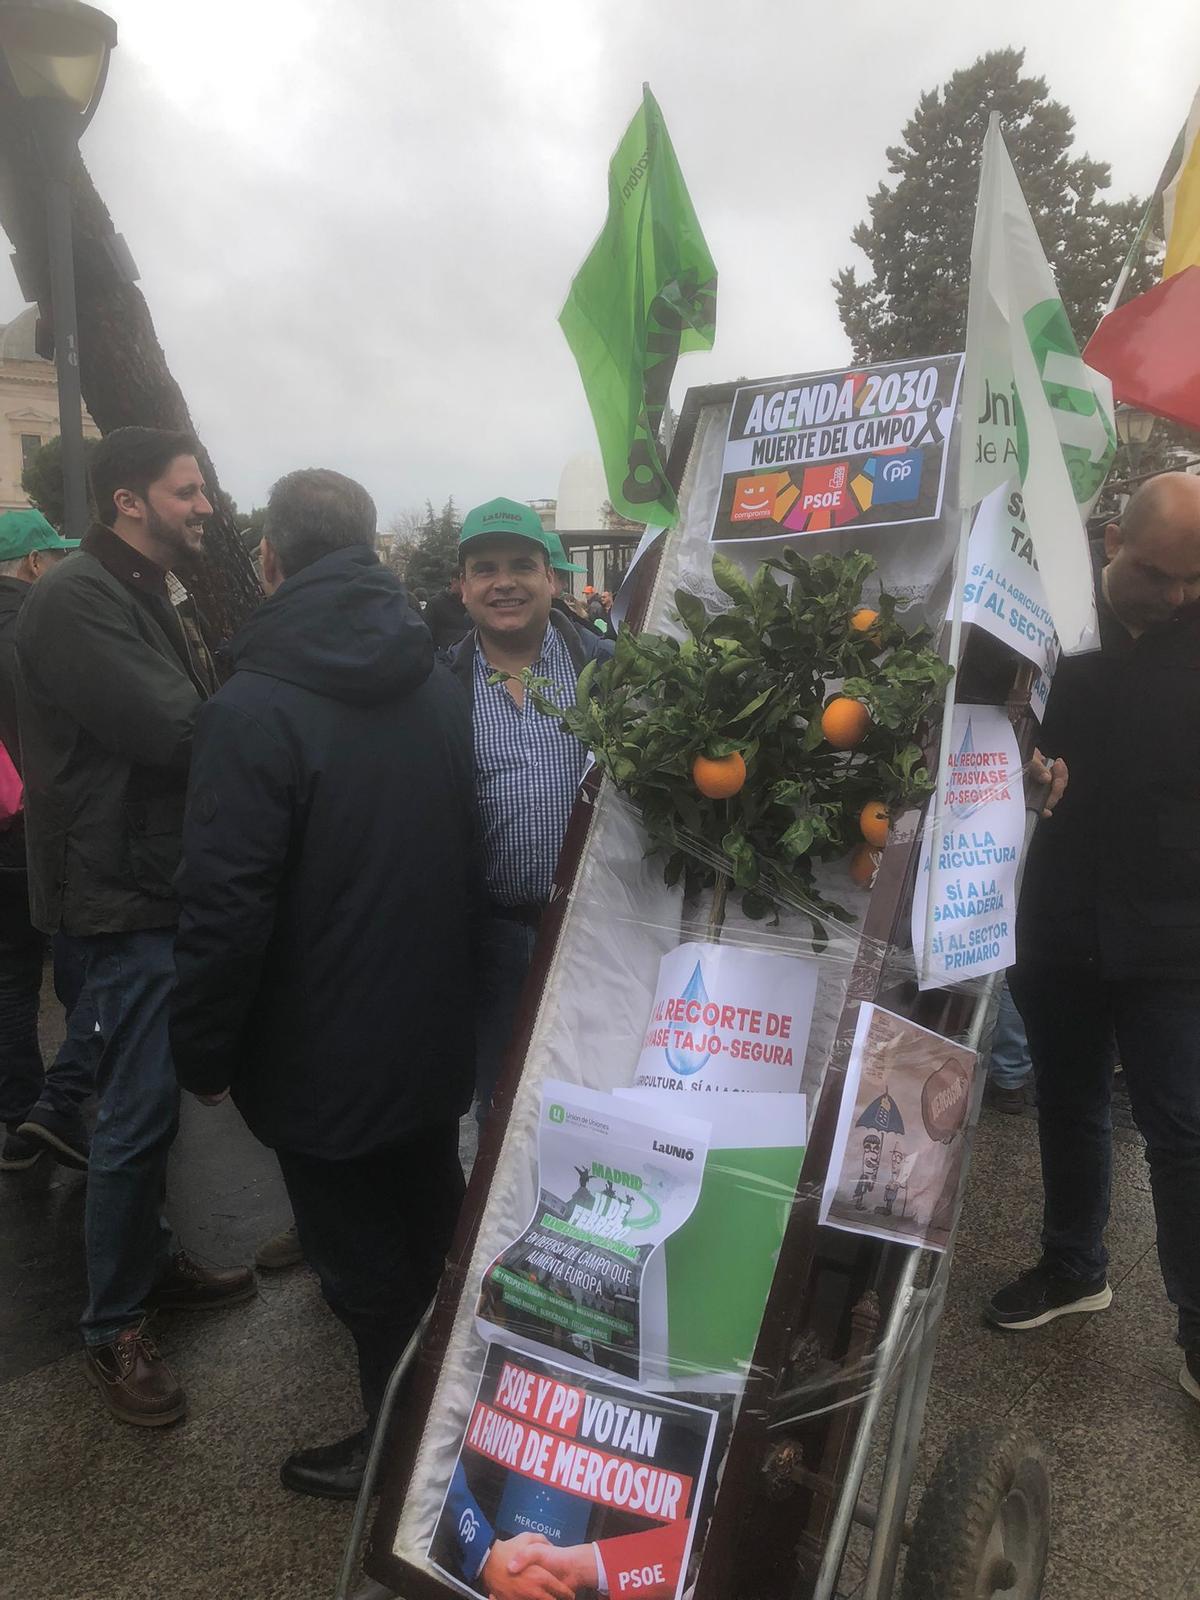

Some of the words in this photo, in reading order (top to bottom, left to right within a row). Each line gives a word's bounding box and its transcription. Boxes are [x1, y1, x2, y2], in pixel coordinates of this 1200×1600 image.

[744, 379, 854, 435] AGENDA
[860, 367, 938, 415] 2030
[751, 432, 816, 466] MUERTE
[818, 425, 849, 453] DEL
[853, 415, 916, 450] CAMPO
[803, 491, 842, 510] PSOE
[971, 563, 986, 577] SÍ
[985, 569, 994, 581] A
[995, 573, 1007, 590] LA
[963, 582, 987, 603] SÍ
[984, 592, 1006, 620] AL
[960, 752, 1008, 767] RECORTE
[943, 831, 954, 851] SÍ
[958, 833, 969, 849] A
[972, 831, 996, 848] LA
[946, 879, 963, 901] SÍ
[967, 882, 979, 898] A
[981, 880, 996, 897] LA
[950, 931, 966, 954] AL
[968, 921, 1008, 947] SECTOR
[945, 941, 1000, 970] PRIMARIO
[664, 998, 762, 1034] RECORTE
[765, 1012, 792, 1039] DE
[673, 1030, 793, 1067] TAJO-SEGURA
[591, 1161, 643, 1192] MADRID
[525, 1232, 540, 1243] EN
[562, 1245, 581, 1261] DEL
[577, 1251, 611, 1276] CAMPO
[610, 1264, 633, 1287] QUE
[525, 1250, 565, 1278] ALIMENTA
[563, 1265, 603, 1296] EUROPA
[495, 1366, 533, 1412] PSOE
[533, 1382, 552, 1419] Y
[549, 1388, 580, 1429] PP
[580, 1394, 663, 1457] VOTAN
[468, 1406, 484, 1444] A
[479, 1410, 524, 1467] FAVOR
[521, 1430, 554, 1478] DE
[550, 1444, 683, 1520] MERCOSUR
[514, 1513, 562, 1540] MERCOSUR
[618, 1564, 666, 1590] PSOE
